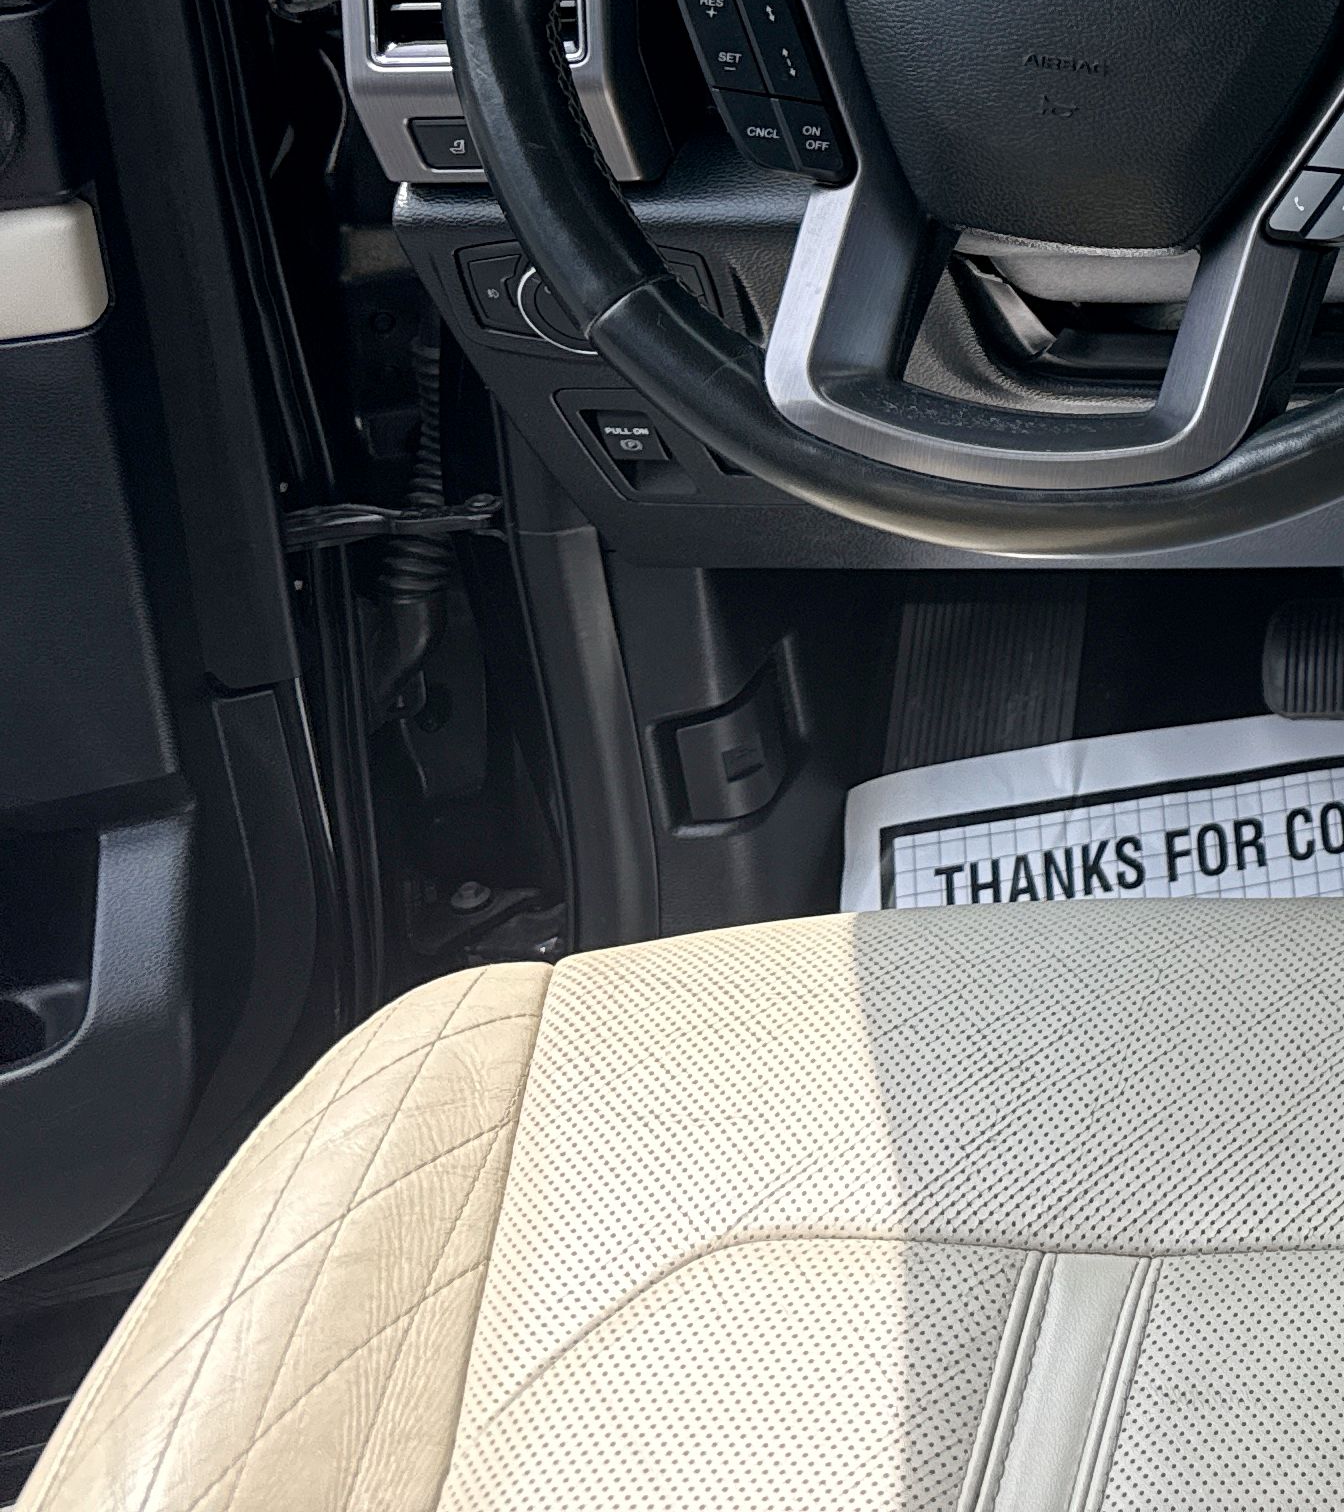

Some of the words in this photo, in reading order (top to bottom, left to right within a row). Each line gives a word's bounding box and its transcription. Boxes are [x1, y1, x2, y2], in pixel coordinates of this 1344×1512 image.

[718, 51, 742, 64] SET
[746, 126, 780, 139] CNCL
[803, 125, 821, 137] ON
[805, 139, 830, 151] OFF
[604, 427, 632, 435] PULL
[632, 427, 649, 435] ON
[934, 835, 1144, 905] THANKS
[1165, 818, 1267, 883] FOR
